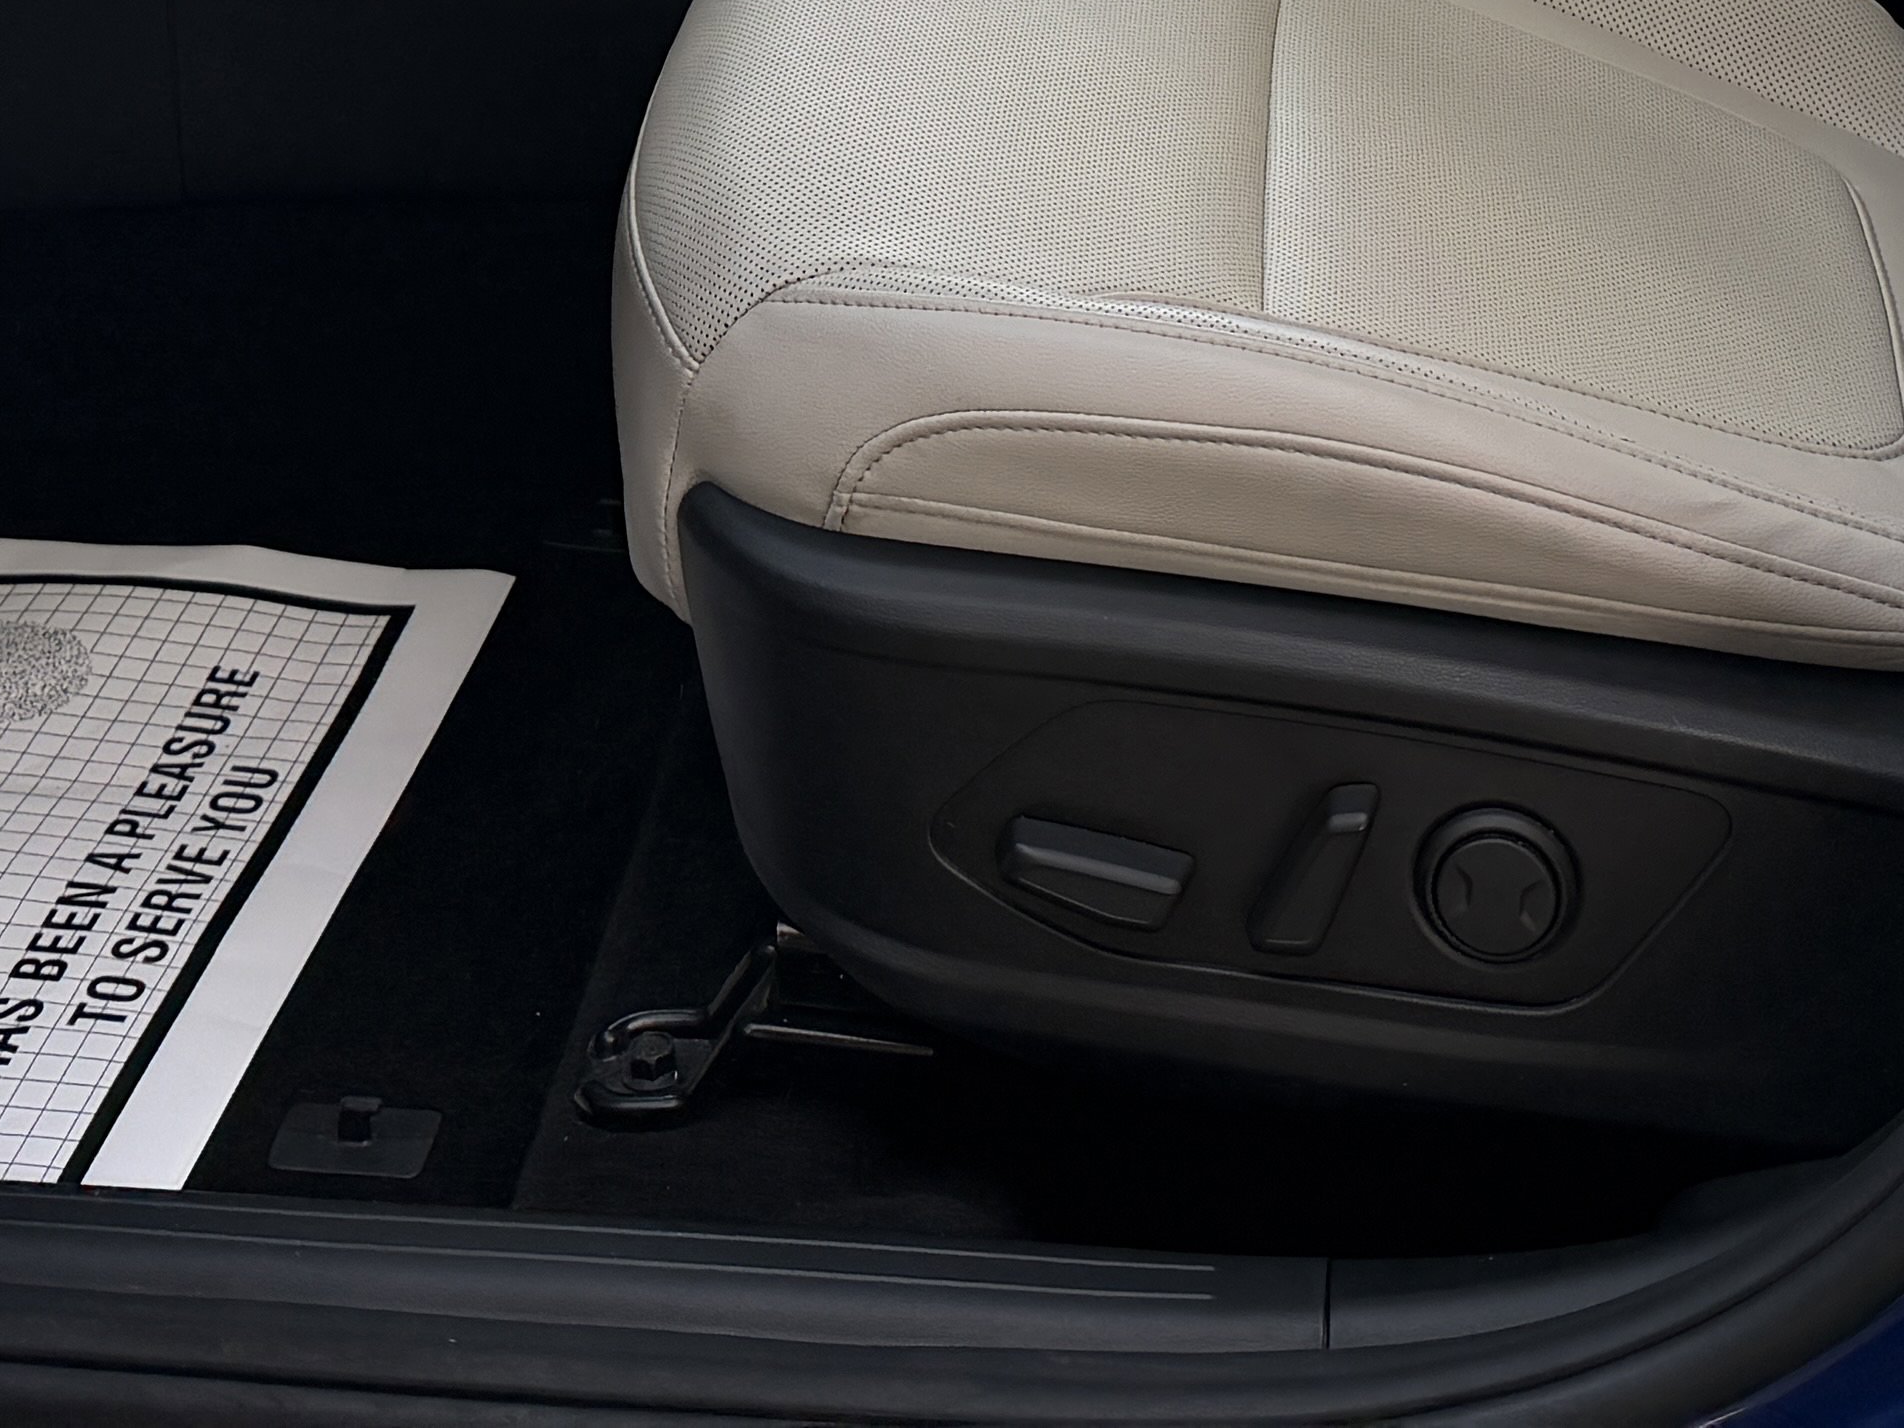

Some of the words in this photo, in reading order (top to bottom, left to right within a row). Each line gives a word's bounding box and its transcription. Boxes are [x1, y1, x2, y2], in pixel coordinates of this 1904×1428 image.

[105, 664, 261, 842] PLEASURE
[9, 879, 118, 983] BEEN
[65, 974, 148, 1027] TO
[110, 843, 232, 964] SERVE
[190, 764, 280, 833] YOU
[84, 846, 143, 876] A
